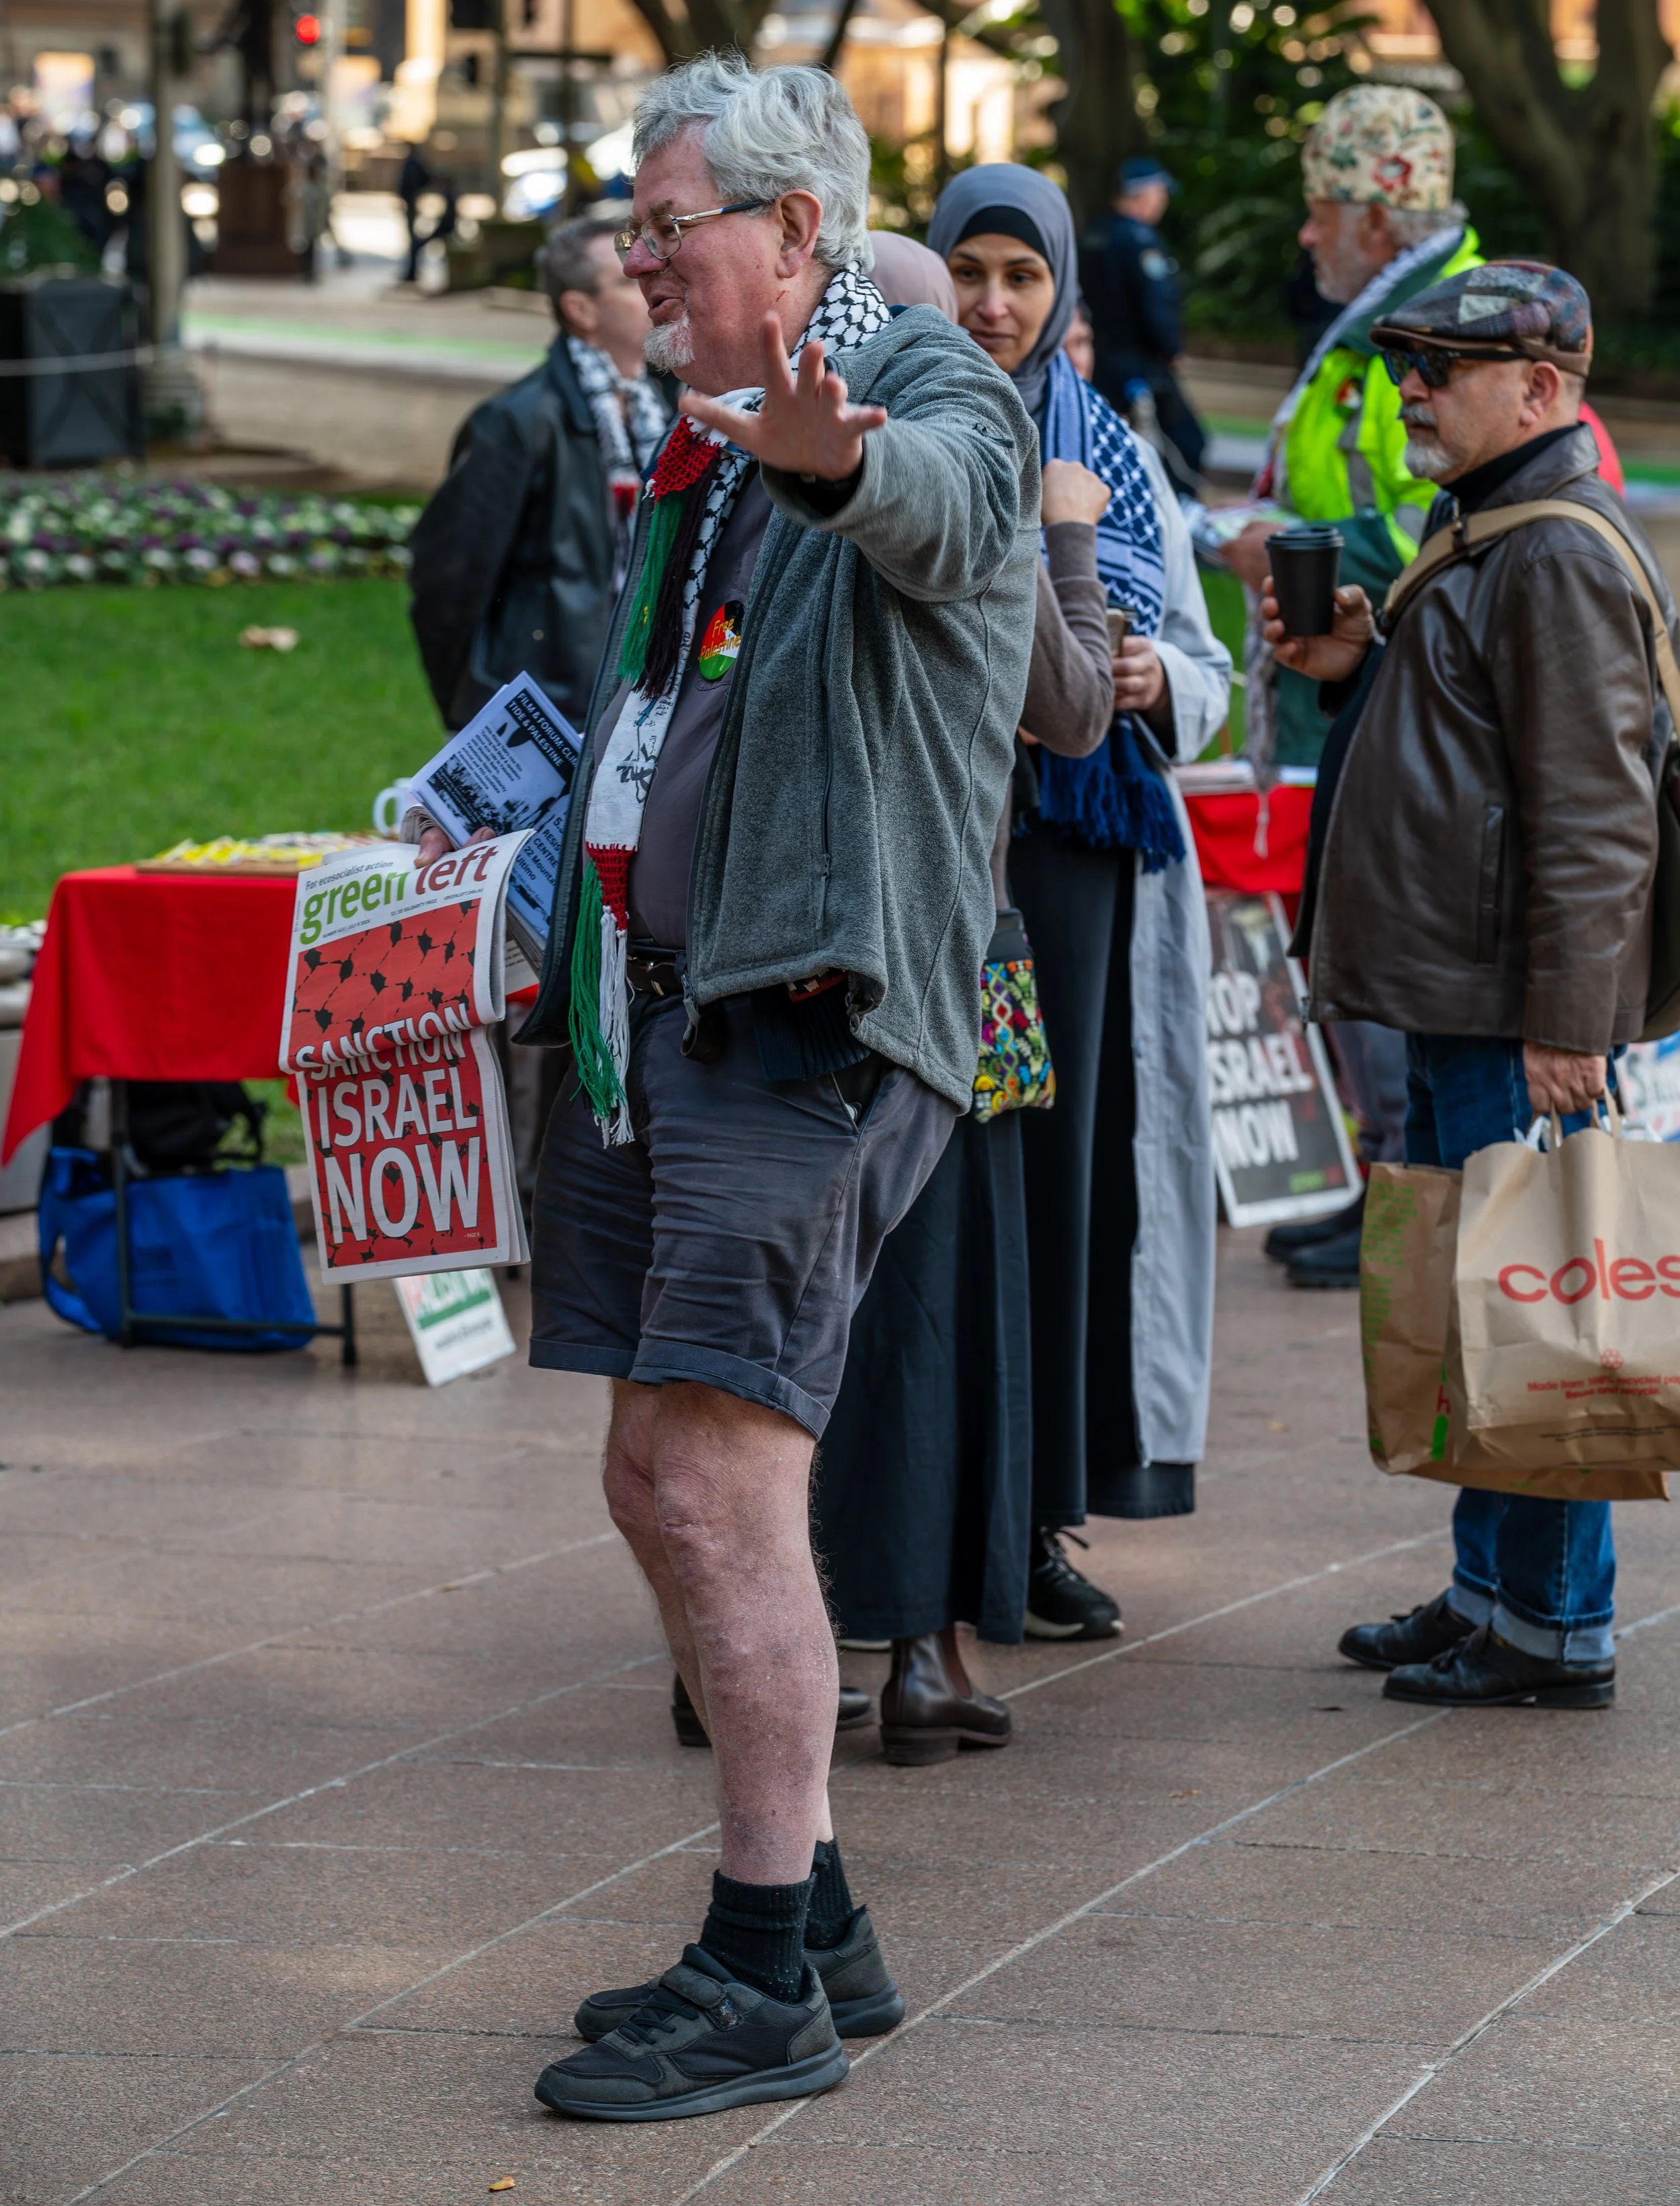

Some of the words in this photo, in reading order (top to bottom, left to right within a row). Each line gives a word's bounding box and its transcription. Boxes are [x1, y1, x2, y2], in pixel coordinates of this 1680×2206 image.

[712, 618, 734, 639] Free
[700, 635, 741, 663] Palestine
[507, 700, 527, 722] TIDE
[517, 692, 536, 714] FILM
[531, 710, 542, 721] &
[521, 718, 532, 727] &
[536, 716, 565, 749] FORUM:
[466, 742, 484, 763] Palestinian
[526, 723, 564, 768] PALESTINE
[457, 750, 474, 772] Palestinian
[499, 764, 515, 782] Palestine
[523, 845, 535, 858] 22
[532, 837, 560, 868] CENTRE
[542, 829, 563, 852] RESIS
[306, 881, 317, 891] For
[319, 864, 364, 887] ecosocialist
[366, 860, 394, 873] action
[514, 854, 539, 881] Ultimo
[300, 871, 409, 945] green
[415, 846, 498, 895] left
[403, 902, 425, 912] SOLIDARITY
[1207, 970, 1261, 1036] OP
[296, 1004, 475, 1081] SANCTION
[1208, 1032, 1313, 1104] SRAEL
[317, 1066, 478, 1149] ISRAEL
[1214, 1101, 1299, 1170] NOW
[324, 1135, 480, 1245] NOW
[1498, 1237, 1680, 1305] coles
[1527, 1382, 1558, 1391] Made
[1560, 1380, 1585, 1389] from
[1616, 1375, 1661, 1385] recycled
